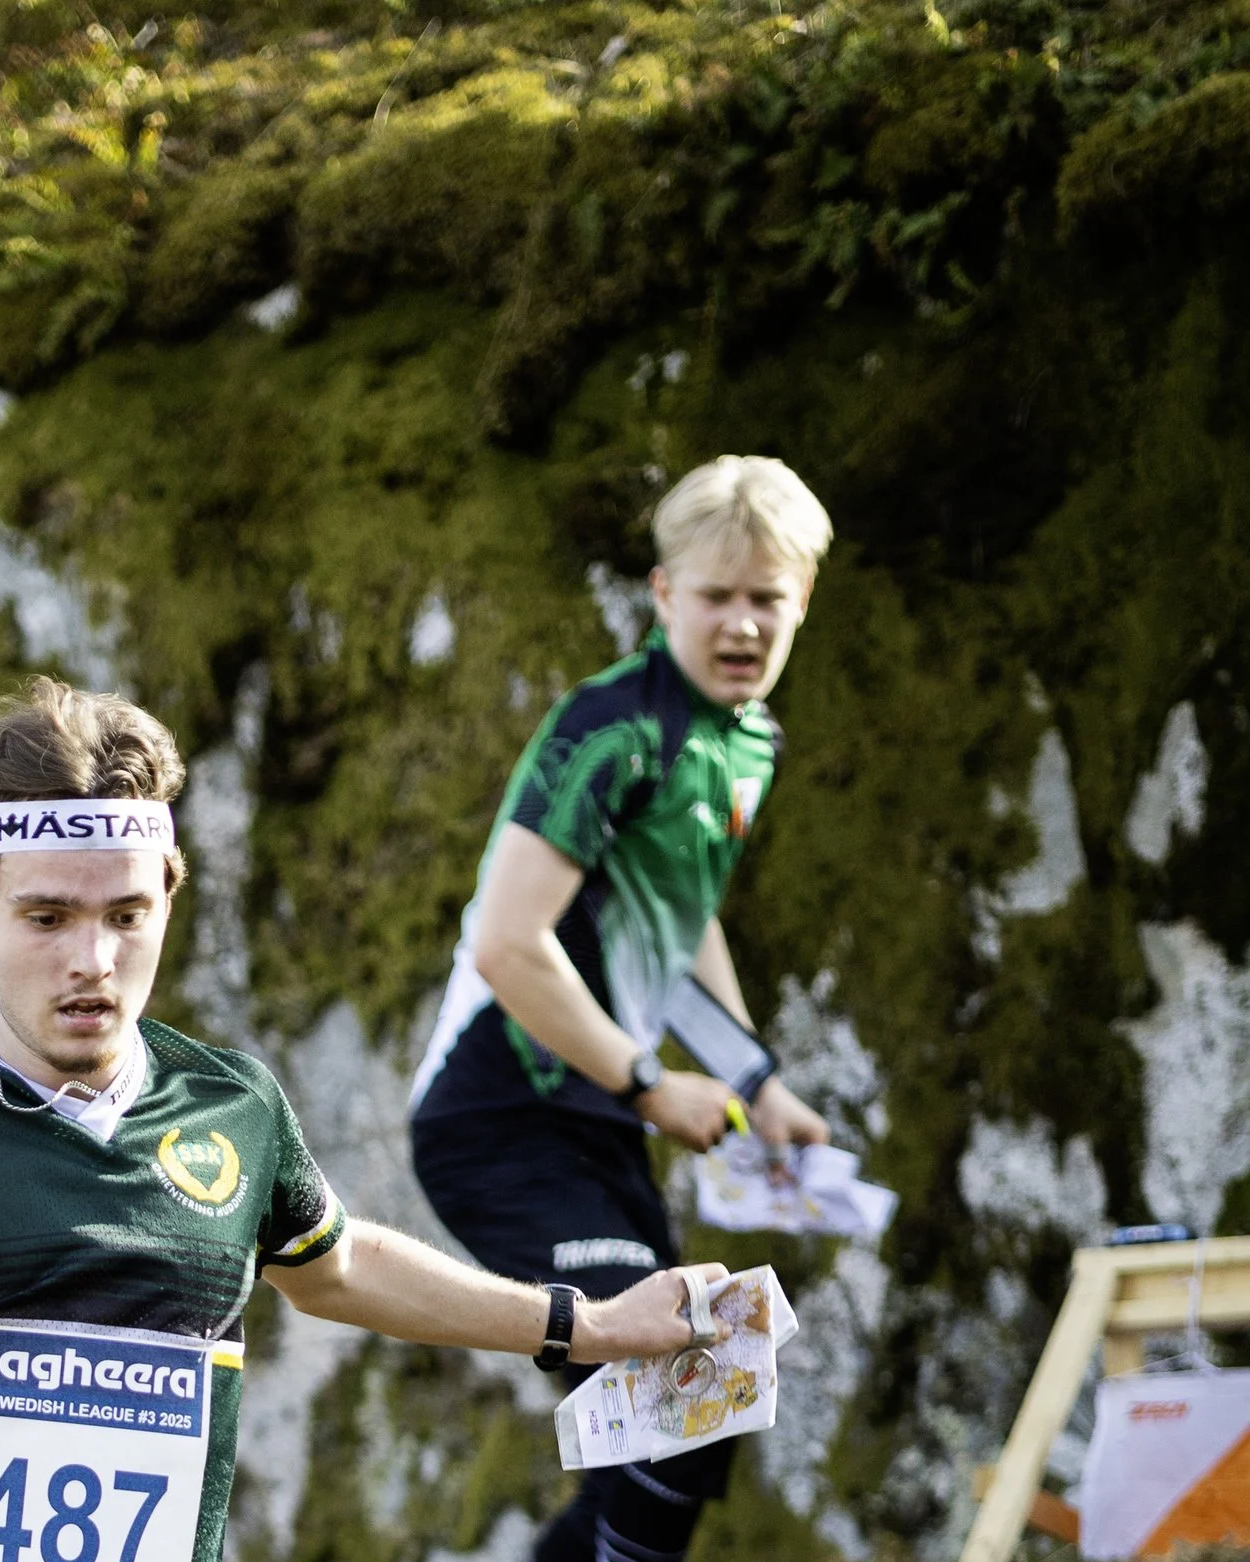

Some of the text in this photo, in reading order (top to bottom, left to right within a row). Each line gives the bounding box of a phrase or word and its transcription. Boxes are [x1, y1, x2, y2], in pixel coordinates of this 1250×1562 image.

[151, 1163, 249, 1217] ORIENTERING HUDDINGE
[68, 1402, 135, 1423] LEAGUE
[138, 1409, 156, 1425] #3
[158, 1411, 193, 1430] 2025
